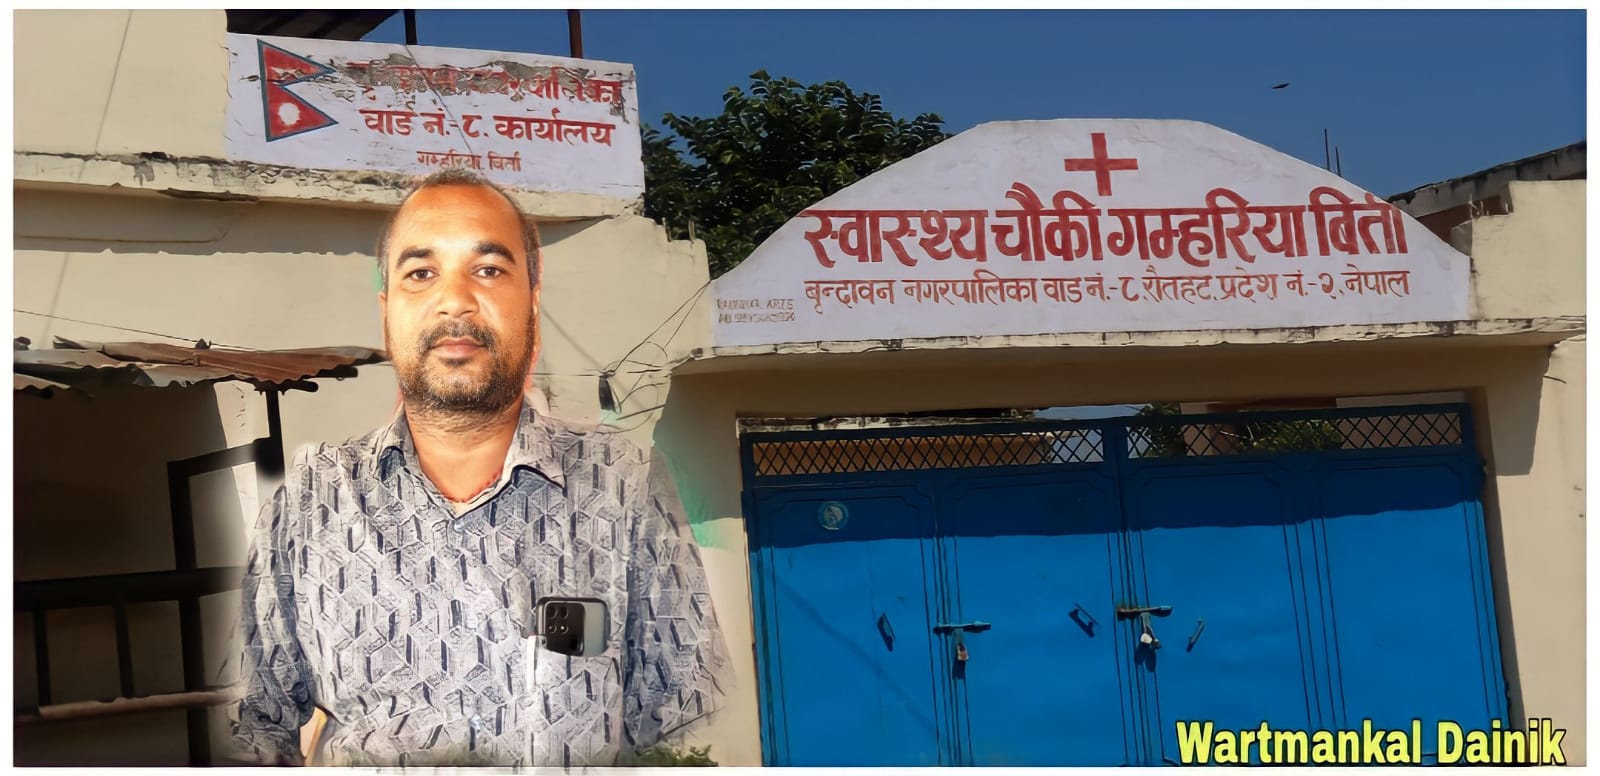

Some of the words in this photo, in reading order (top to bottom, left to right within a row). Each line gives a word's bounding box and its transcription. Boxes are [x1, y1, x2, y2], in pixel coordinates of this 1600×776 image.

[493, 108, 617, 147] कार्यालय
[799, 209, 989, 268] स्वास्थ्य
[990, 181, 1104, 262] चौकी
[1107, 187, 1307, 267] गम्हरिया
[901, 269, 1039, 305] नगरपालिका
[1215, 267, 1279, 303] प्रदेश
[1341, 263, 1411, 298] नेपाल
